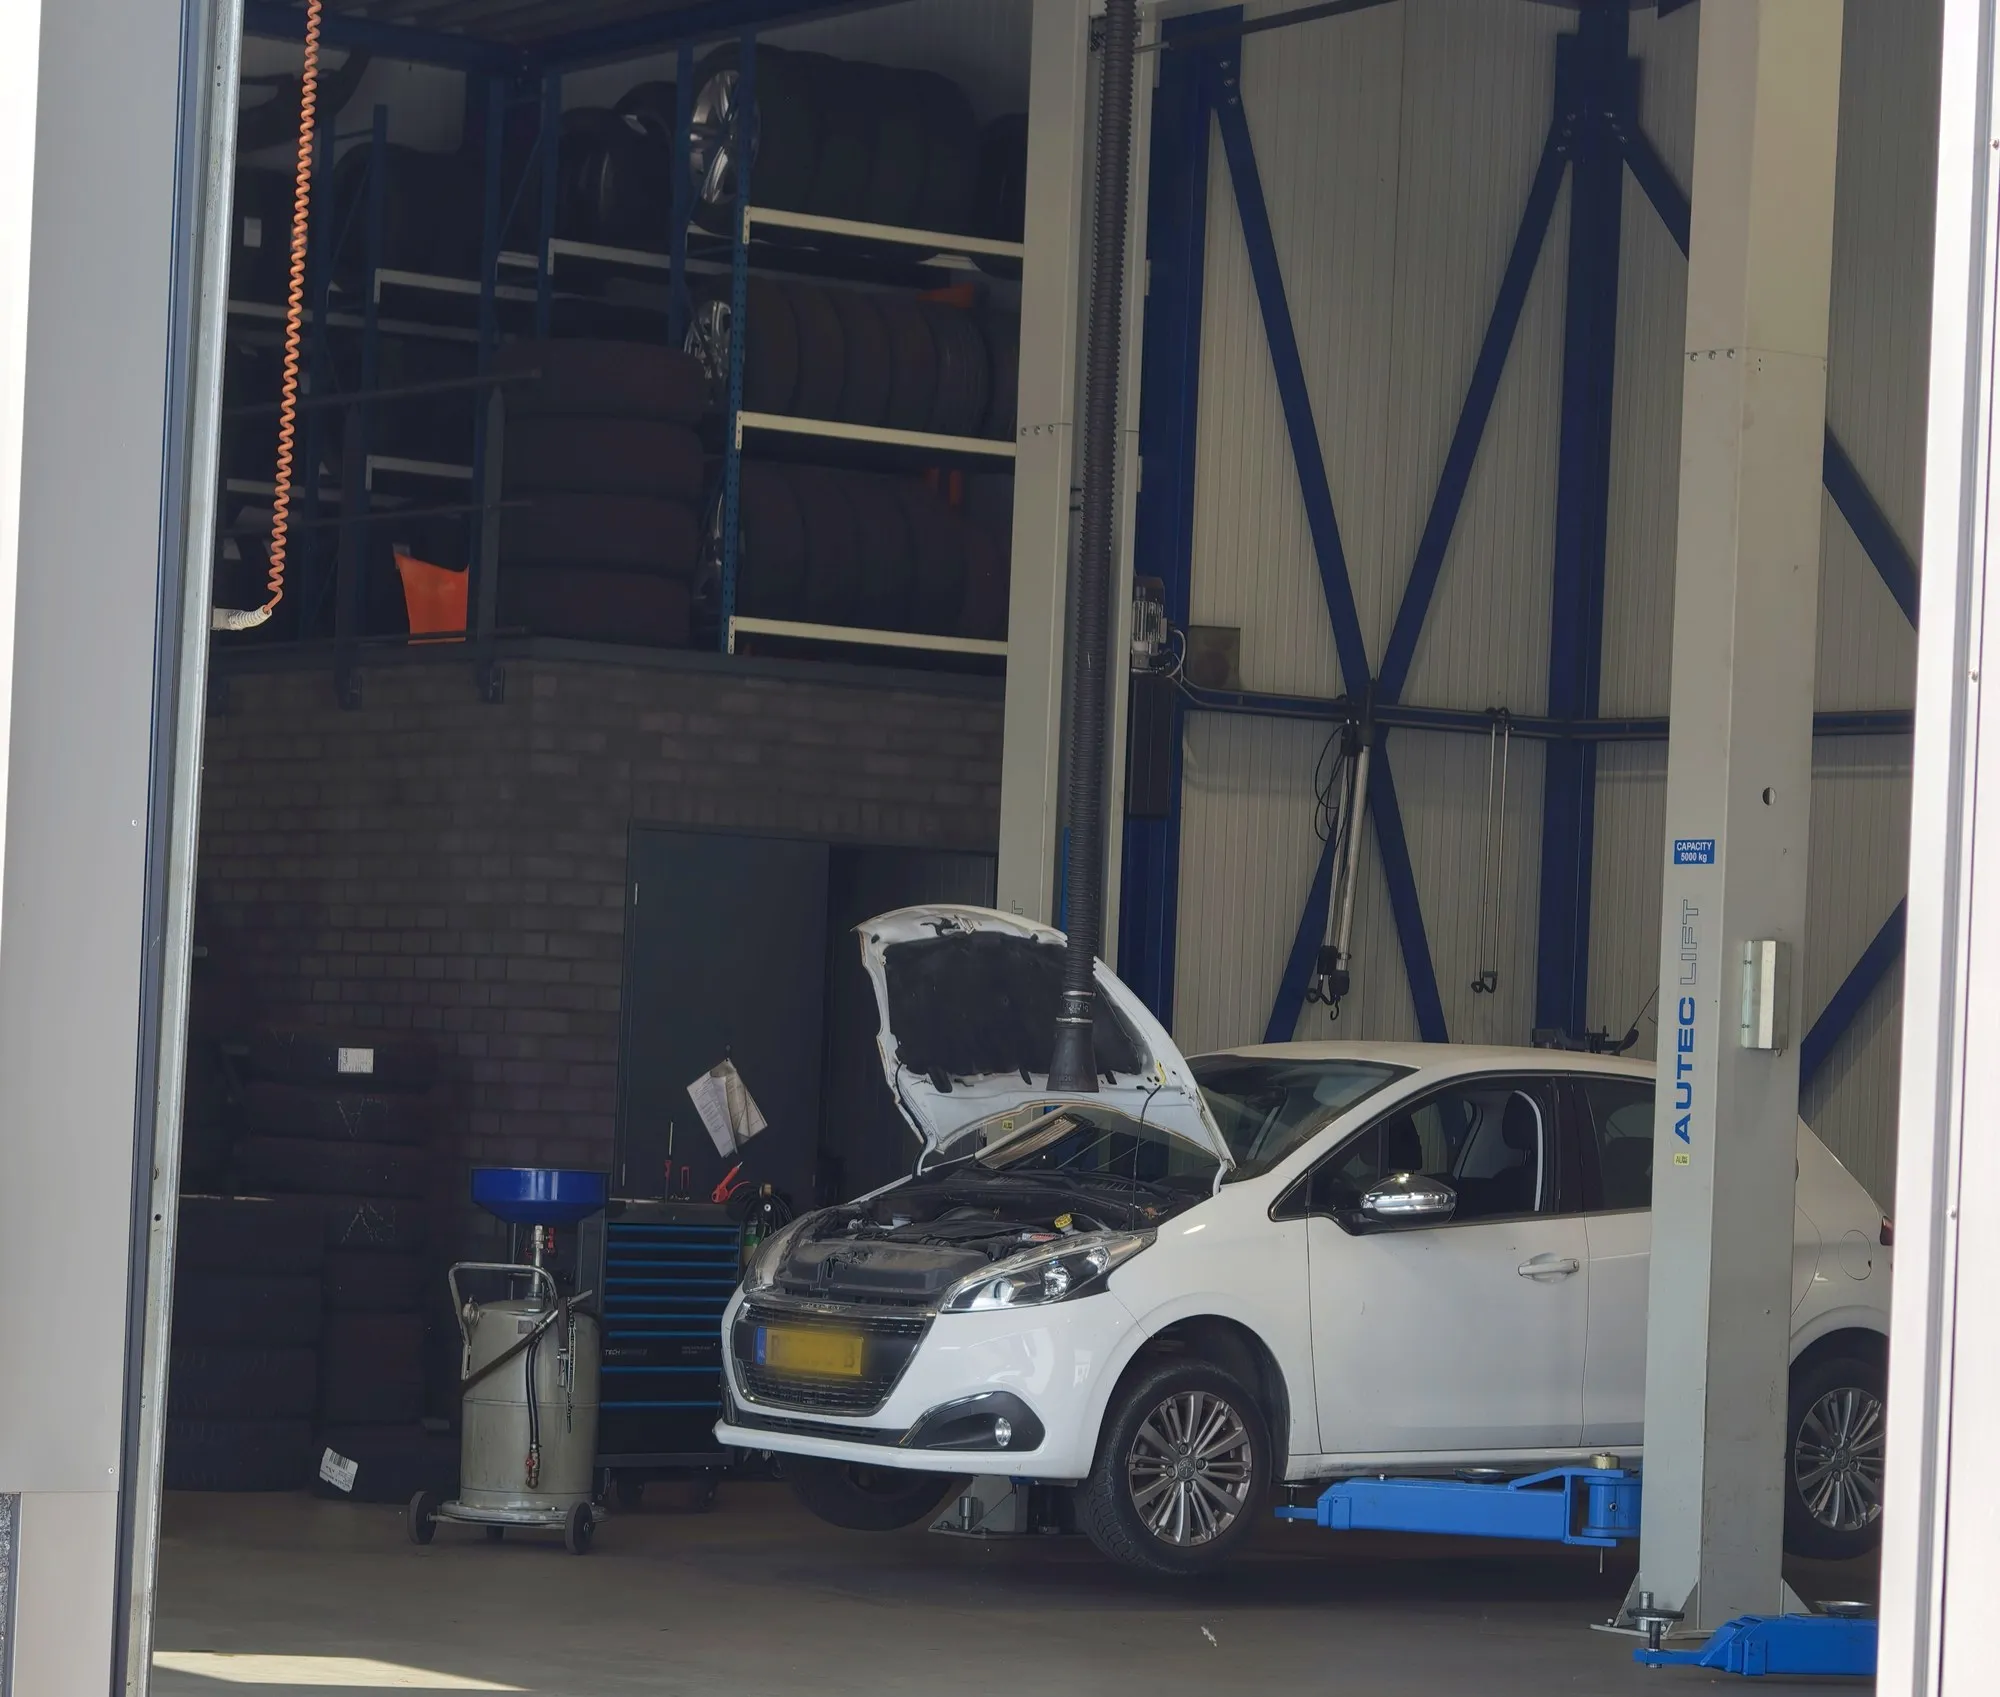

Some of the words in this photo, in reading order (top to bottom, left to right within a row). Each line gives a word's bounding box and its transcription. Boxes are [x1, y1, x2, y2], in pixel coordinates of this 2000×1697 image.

[1677, 842, 1712, 851] CAPACITY
[1681, 852, 1697, 861] 5000
[1698, 852, 1707, 863] kg
[1680, 899, 1699, 986] LIFT
[1674, 996, 1696, 1145] AUTEC
